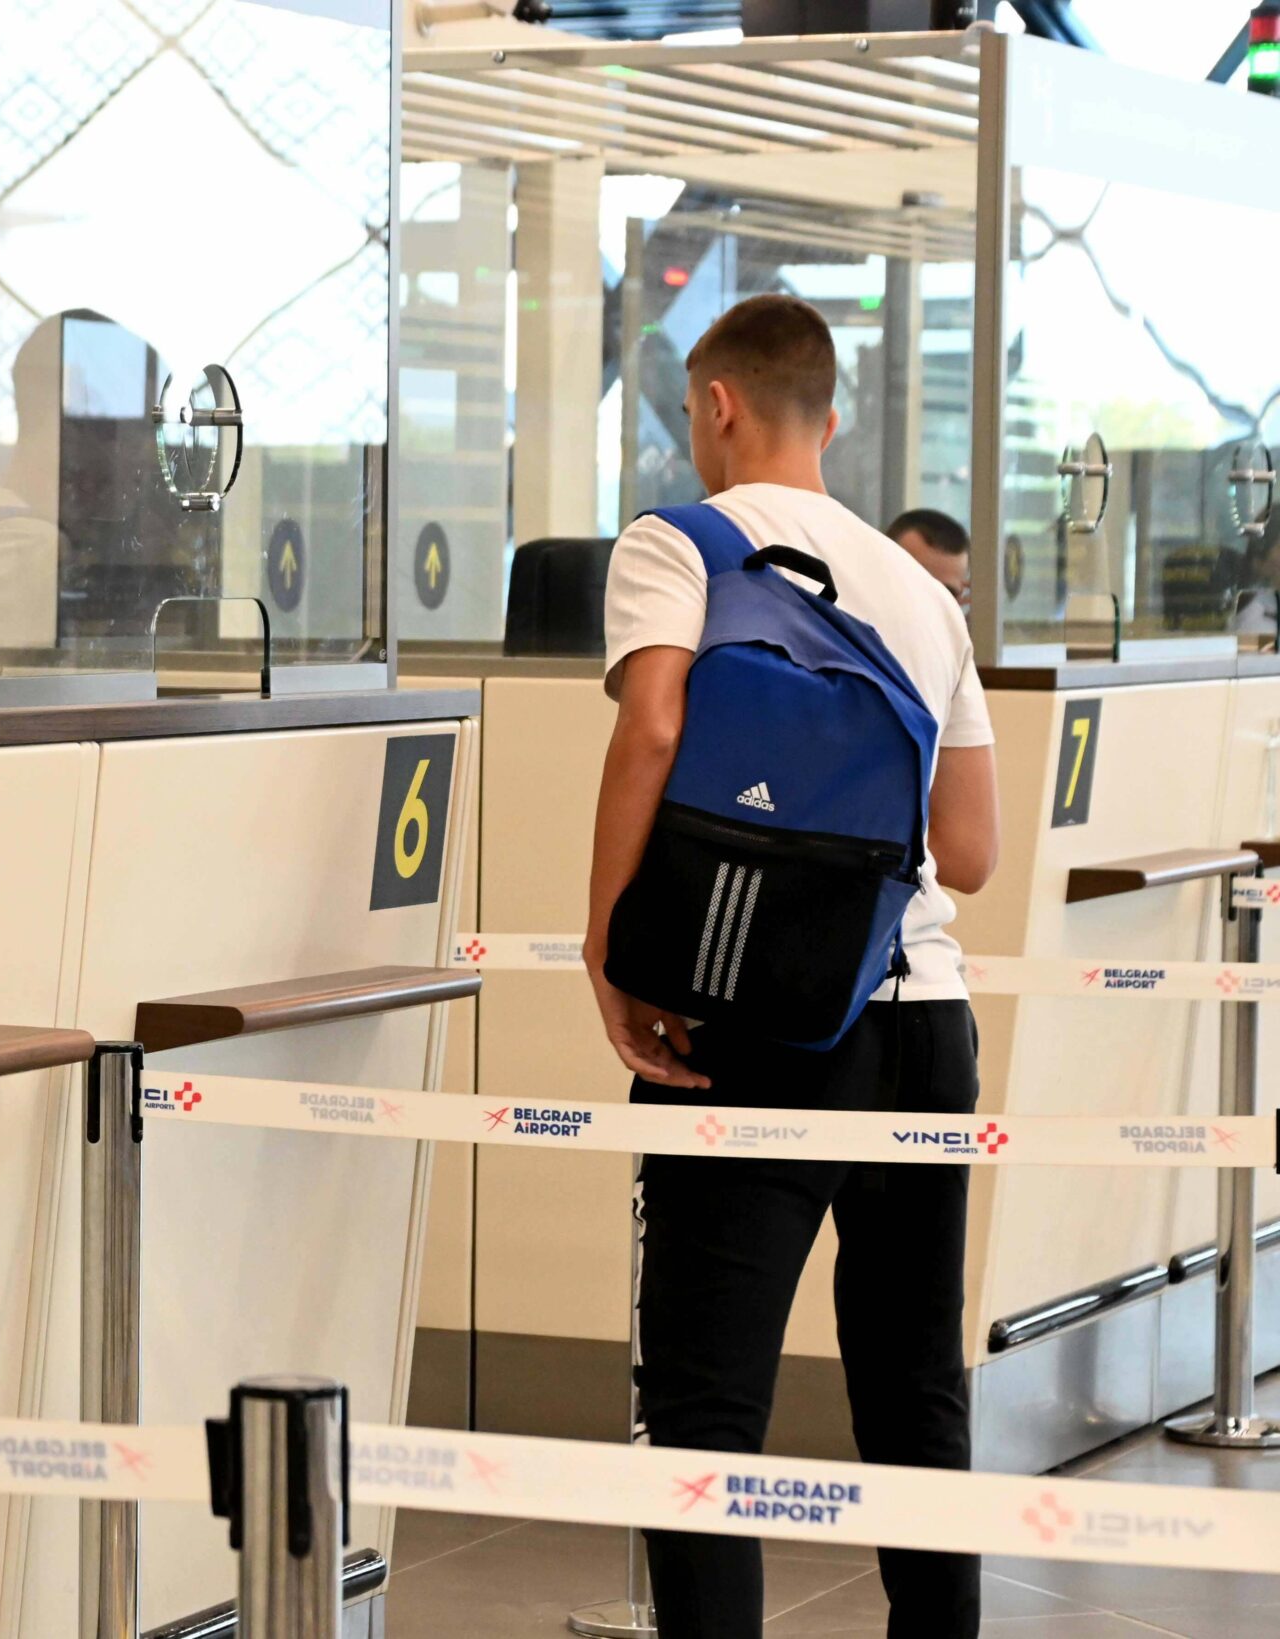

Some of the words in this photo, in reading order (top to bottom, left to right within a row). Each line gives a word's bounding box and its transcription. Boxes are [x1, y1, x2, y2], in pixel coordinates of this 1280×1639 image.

[1064, 718, 1090, 808] 7
[736, 795, 775, 812] adidas
[394, 759, 430, 879] 6
[1104, 968, 1166, 980] BELGRADE
[145, 1102, 176, 1110] AIRPORTS
[514, 1107, 592, 1124] BELGRADE
[892, 1131, 970, 1145] VINCI
[726, 1474, 862, 1505] BELGRADE
